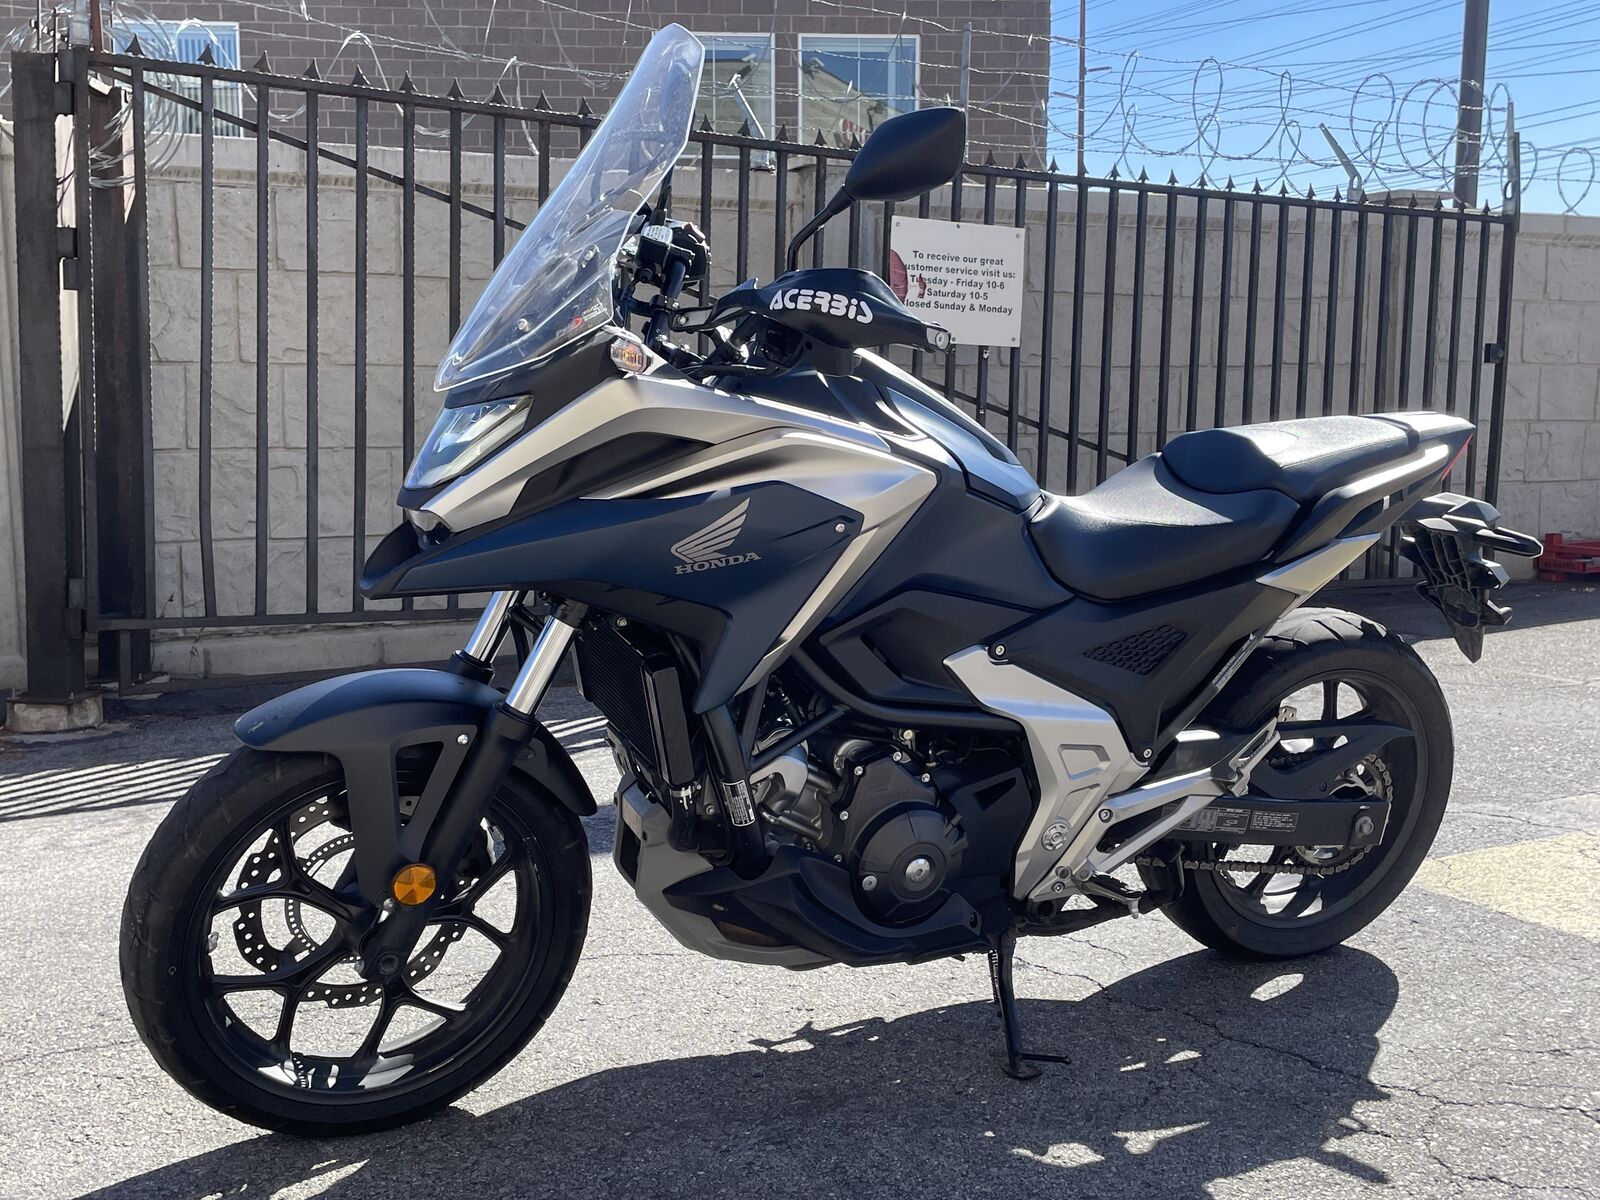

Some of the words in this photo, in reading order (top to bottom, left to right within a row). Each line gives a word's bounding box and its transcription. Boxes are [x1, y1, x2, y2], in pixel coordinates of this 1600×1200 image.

[912, 250, 924, 259] To
[926, 252, 960, 262] receive
[963, 256, 977, 264] our
[980, 257, 1004, 266] great
[904, 263, 943, 273] ustomer
[945, 267, 978, 275] service
[981, 268, 1000, 277] visit
[1002, 271, 1016, 279] us:
[956, 278, 984, 289] Friday
[987, 280, 1005, 290] 10-6
[926, 288, 967, 300] Saturday
[970, 291, 989, 300] 10-5
[906, 298, 931, 308] losed
[933, 301, 966, 313] Sunday
[969, 303, 976, 311] &
[978, 304, 1013, 316] Monday
[674, 552, 762, 575] HONDA
